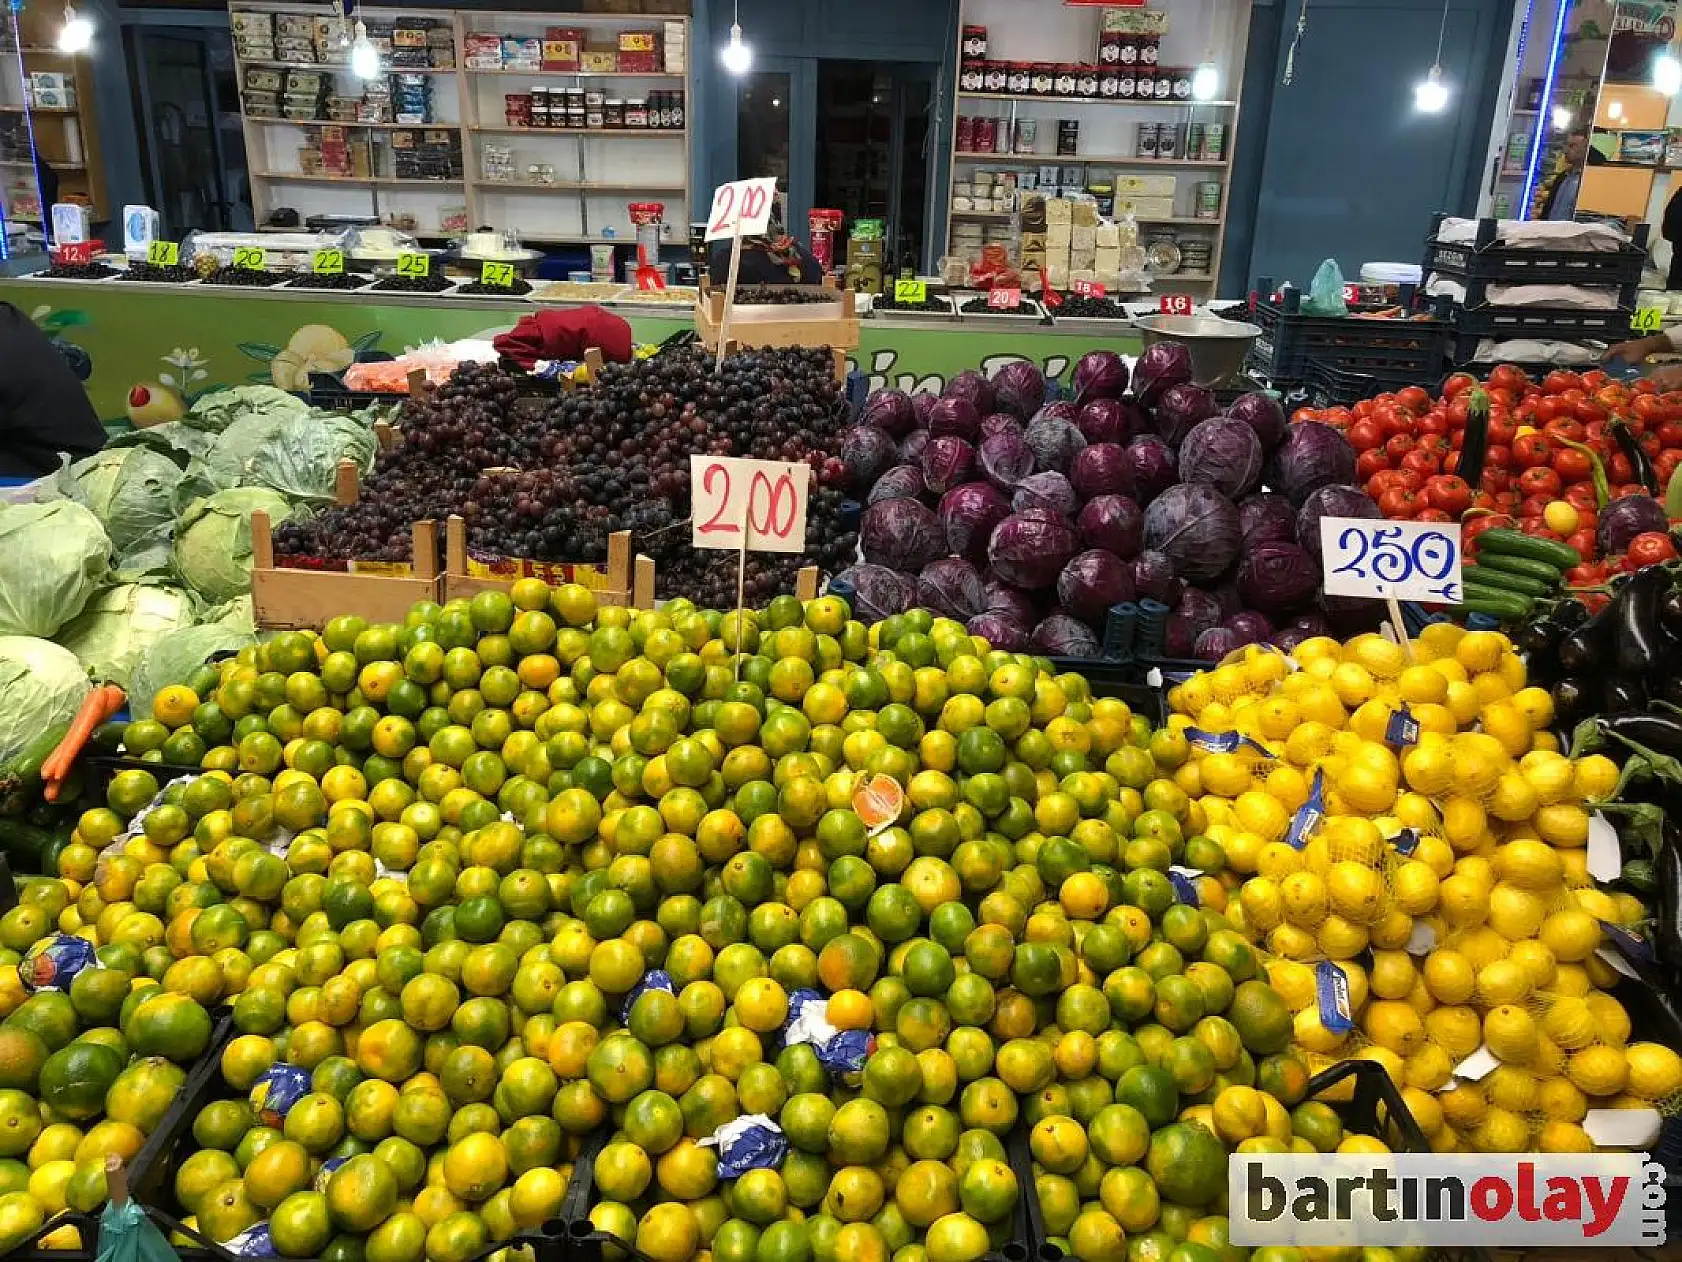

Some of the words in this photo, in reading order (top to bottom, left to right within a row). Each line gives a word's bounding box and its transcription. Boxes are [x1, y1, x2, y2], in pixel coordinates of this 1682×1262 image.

[63, 246, 78, 261] 12
[237, 250, 263, 267] 20
[315, 251, 342, 269] 22
[401, 254, 426, 274] 25
[484, 264, 512, 282] 27
[898, 282, 923, 297] 22
[991, 291, 1009, 304] 20
